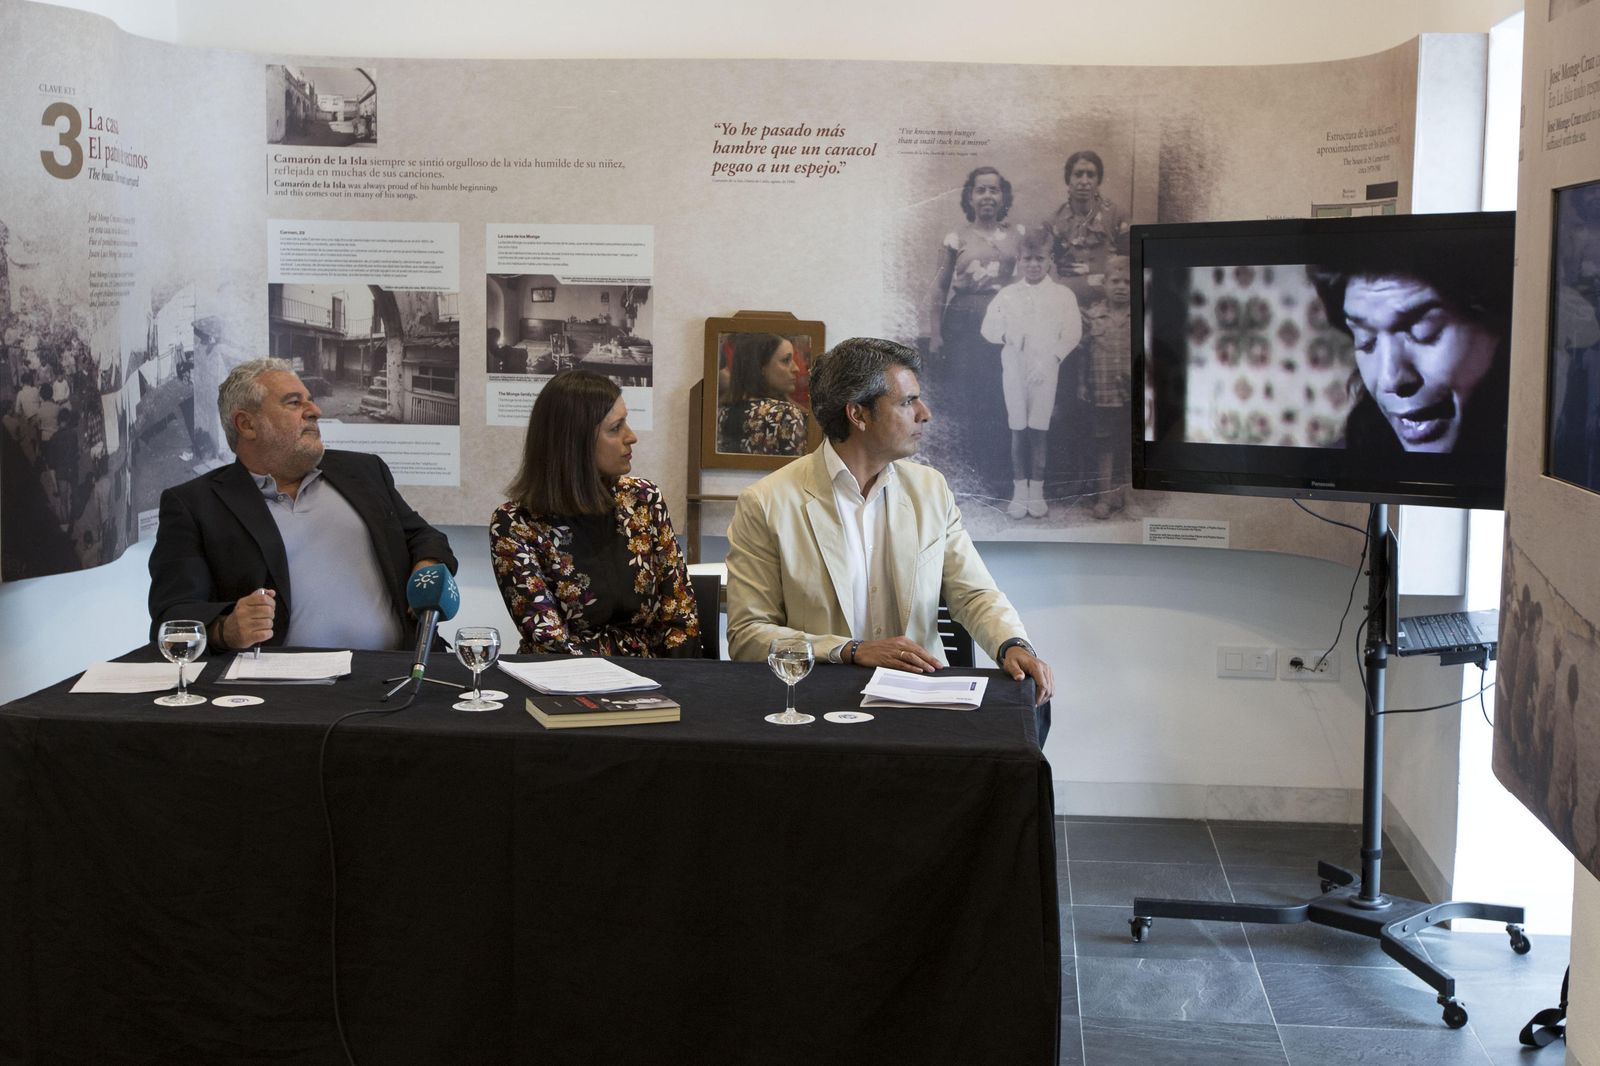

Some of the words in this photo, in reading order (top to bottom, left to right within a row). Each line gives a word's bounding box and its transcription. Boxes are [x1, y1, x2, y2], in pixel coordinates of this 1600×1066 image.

[38, 84, 64, 94] CLAVE
[88, 108, 103, 130] La
[714, 122, 737, 136] “Yo
[741, 122, 758, 136] he
[760, 123, 812, 140] pasado
[816, 124, 846, 137] más
[40, 102, 84, 180] 3
[88, 136, 101, 159] El
[712, 140, 767, 154] hambre
[771, 144, 797, 159] que
[801, 146, 821, 156] un
[825, 143, 878, 157] caracol
[274, 154, 321, 164] Camarón
[324, 156, 336, 165] de
[339, 156, 347, 165] la
[350, 156, 367, 165] Isla
[370, 158, 405, 168] siempre
[420, 157, 444, 166] sintió
[446, 158, 488, 169] orgulloso
[491, 158, 501, 167] de
[504, 158, 511, 167] la
[514, 158, 532, 168] vida
[535, 158, 571, 168] humilde
[573, 158, 584, 168] de
[599, 159, 625, 170] niñez,
[712, 160, 753, 176] pegao
[757, 163, 766, 173] a
[771, 163, 790, 173] un
[794, 160, 846, 178] espejo.”
[88, 167, 100, 180] The
[274, 166, 314, 177] reflejada
[331, 168, 367, 177] muchas
[369, 168, 380, 177] de
[399, 169, 444, 178] canciones.
[388, 183, 408, 191] proud
[460, 184, 498, 193] beginnings
